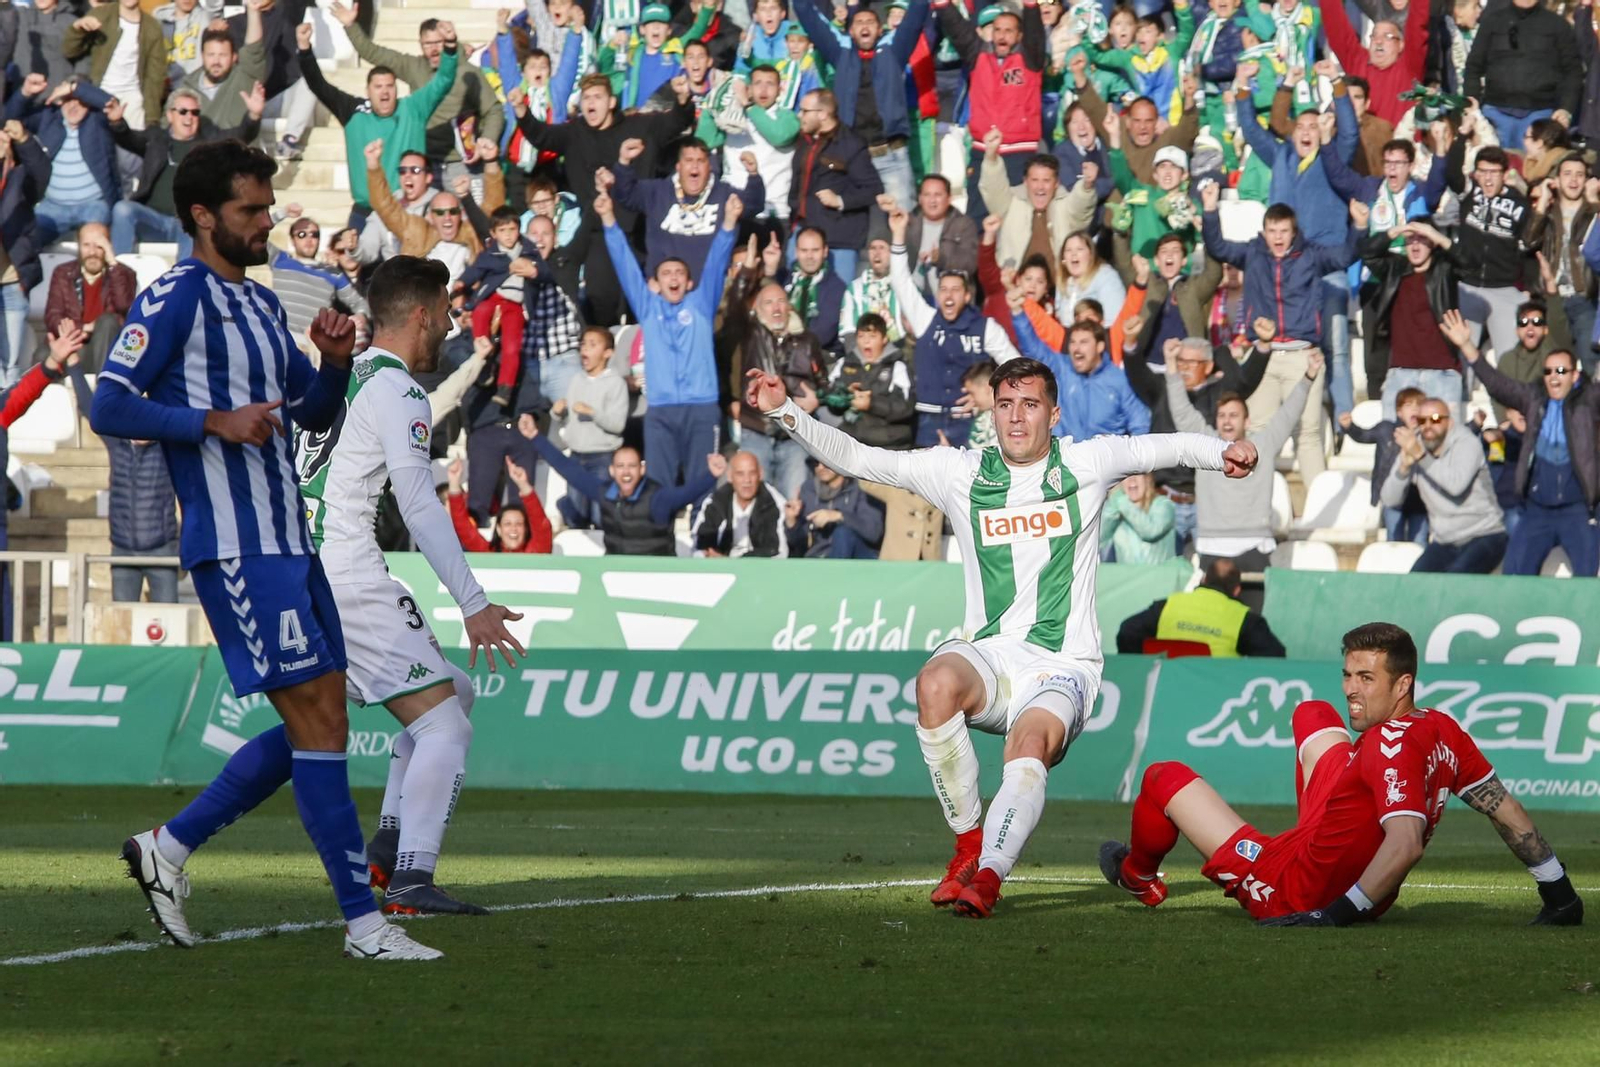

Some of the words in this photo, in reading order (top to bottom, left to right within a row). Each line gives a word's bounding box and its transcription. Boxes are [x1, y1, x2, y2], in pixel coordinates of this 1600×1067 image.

[984, 508, 1063, 538] tango
[279, 609, 308, 655] 4
[772, 610, 818, 651] de
[830, 598, 916, 652] total
[279, 653, 319, 673] hummel
[521, 669, 619, 718] TU
[681, 735, 897, 777] uco.es
[934, 770, 959, 819] CORDOBA
[994, 807, 1017, 850] CORDOBA
